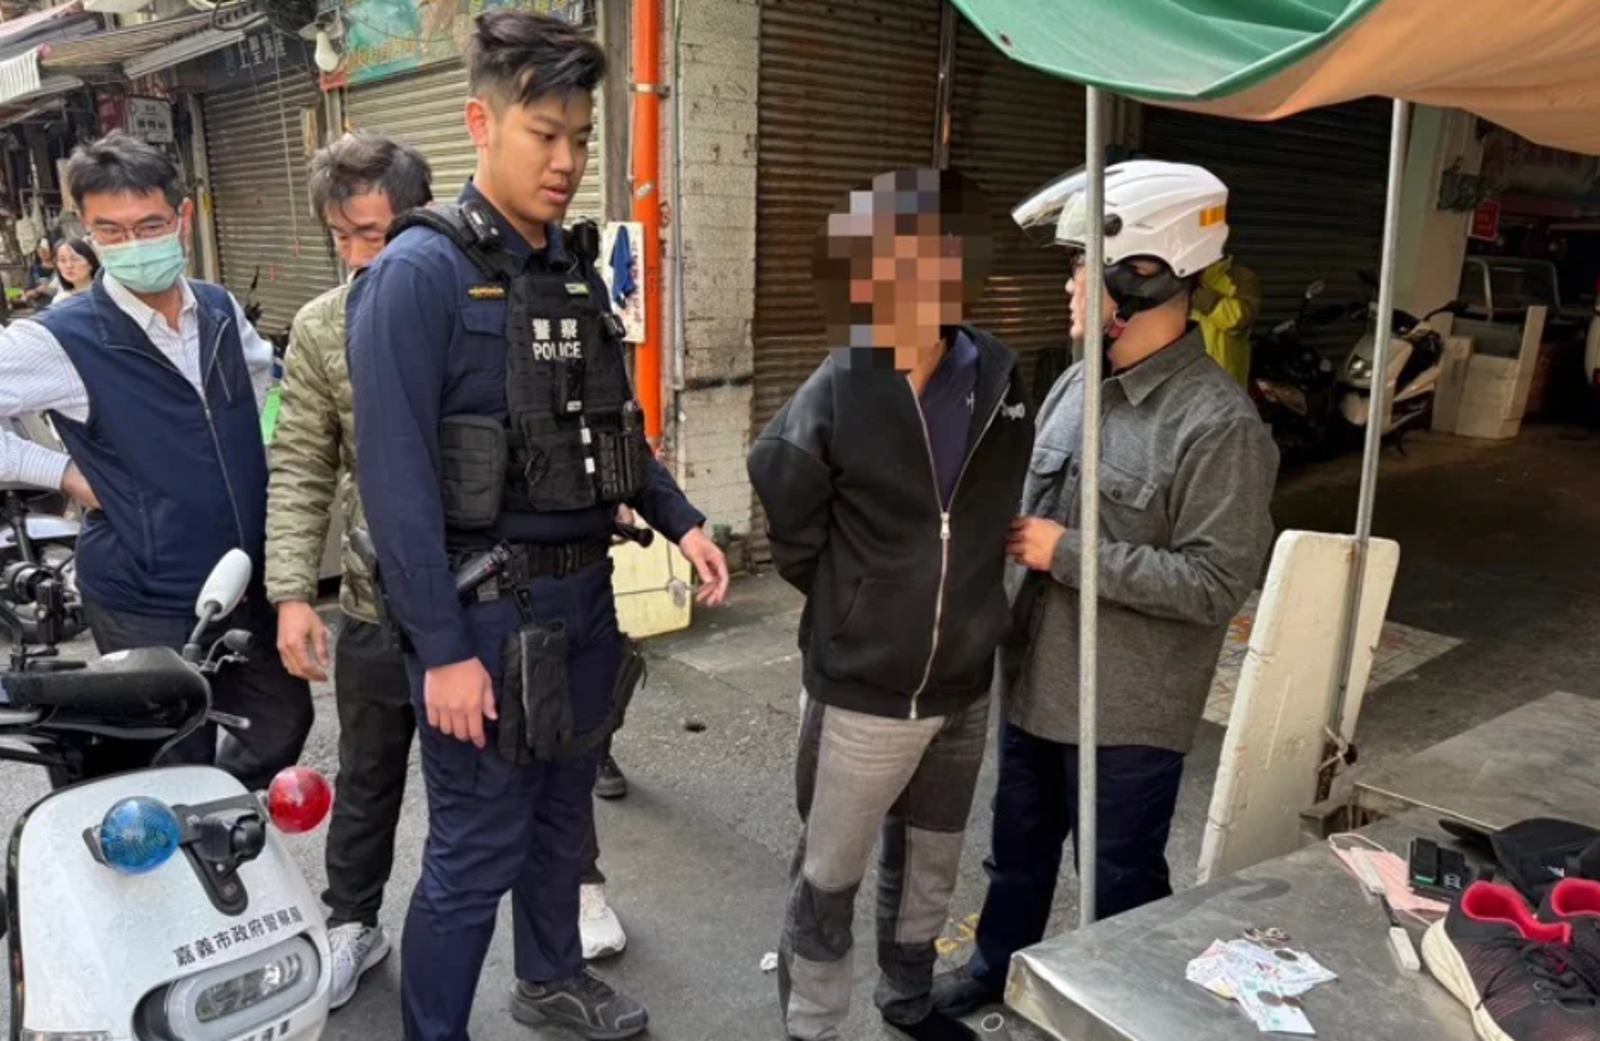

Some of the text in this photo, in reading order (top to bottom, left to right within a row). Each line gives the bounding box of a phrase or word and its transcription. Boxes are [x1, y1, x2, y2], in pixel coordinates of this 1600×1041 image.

[532, 318, 578, 340] 警察
[532, 341, 583, 361] POLICE
[173, 906, 304, 967] 嘉義市政府警察局
